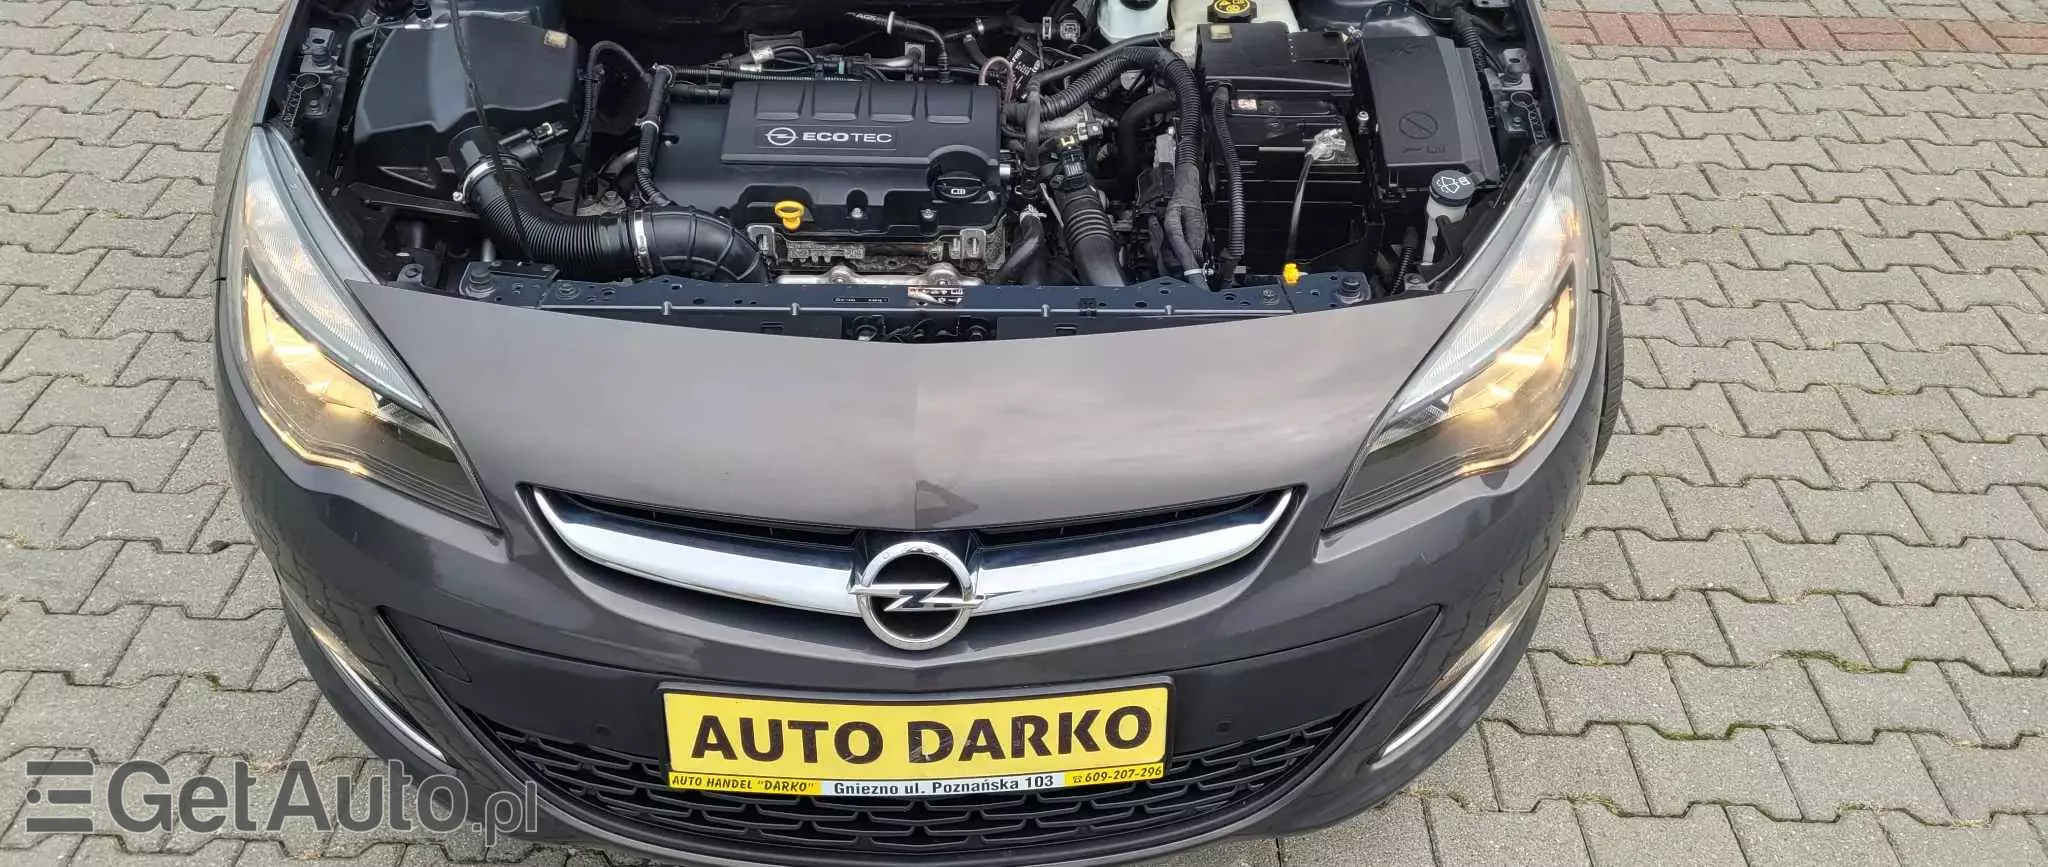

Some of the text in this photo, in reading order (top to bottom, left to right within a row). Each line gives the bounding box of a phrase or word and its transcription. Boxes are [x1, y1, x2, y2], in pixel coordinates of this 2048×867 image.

[802, 131, 893, 144] ECOTEC
[690, 705, 1153, 765] AUTO DARKO
[1084, 765, 1163, 783] 609-207-296
[671, 775, 815, 792] AUTO HANDEL "DARKO"
[834, 774, 1054, 796] Gniezno ul. Poznańska 103
